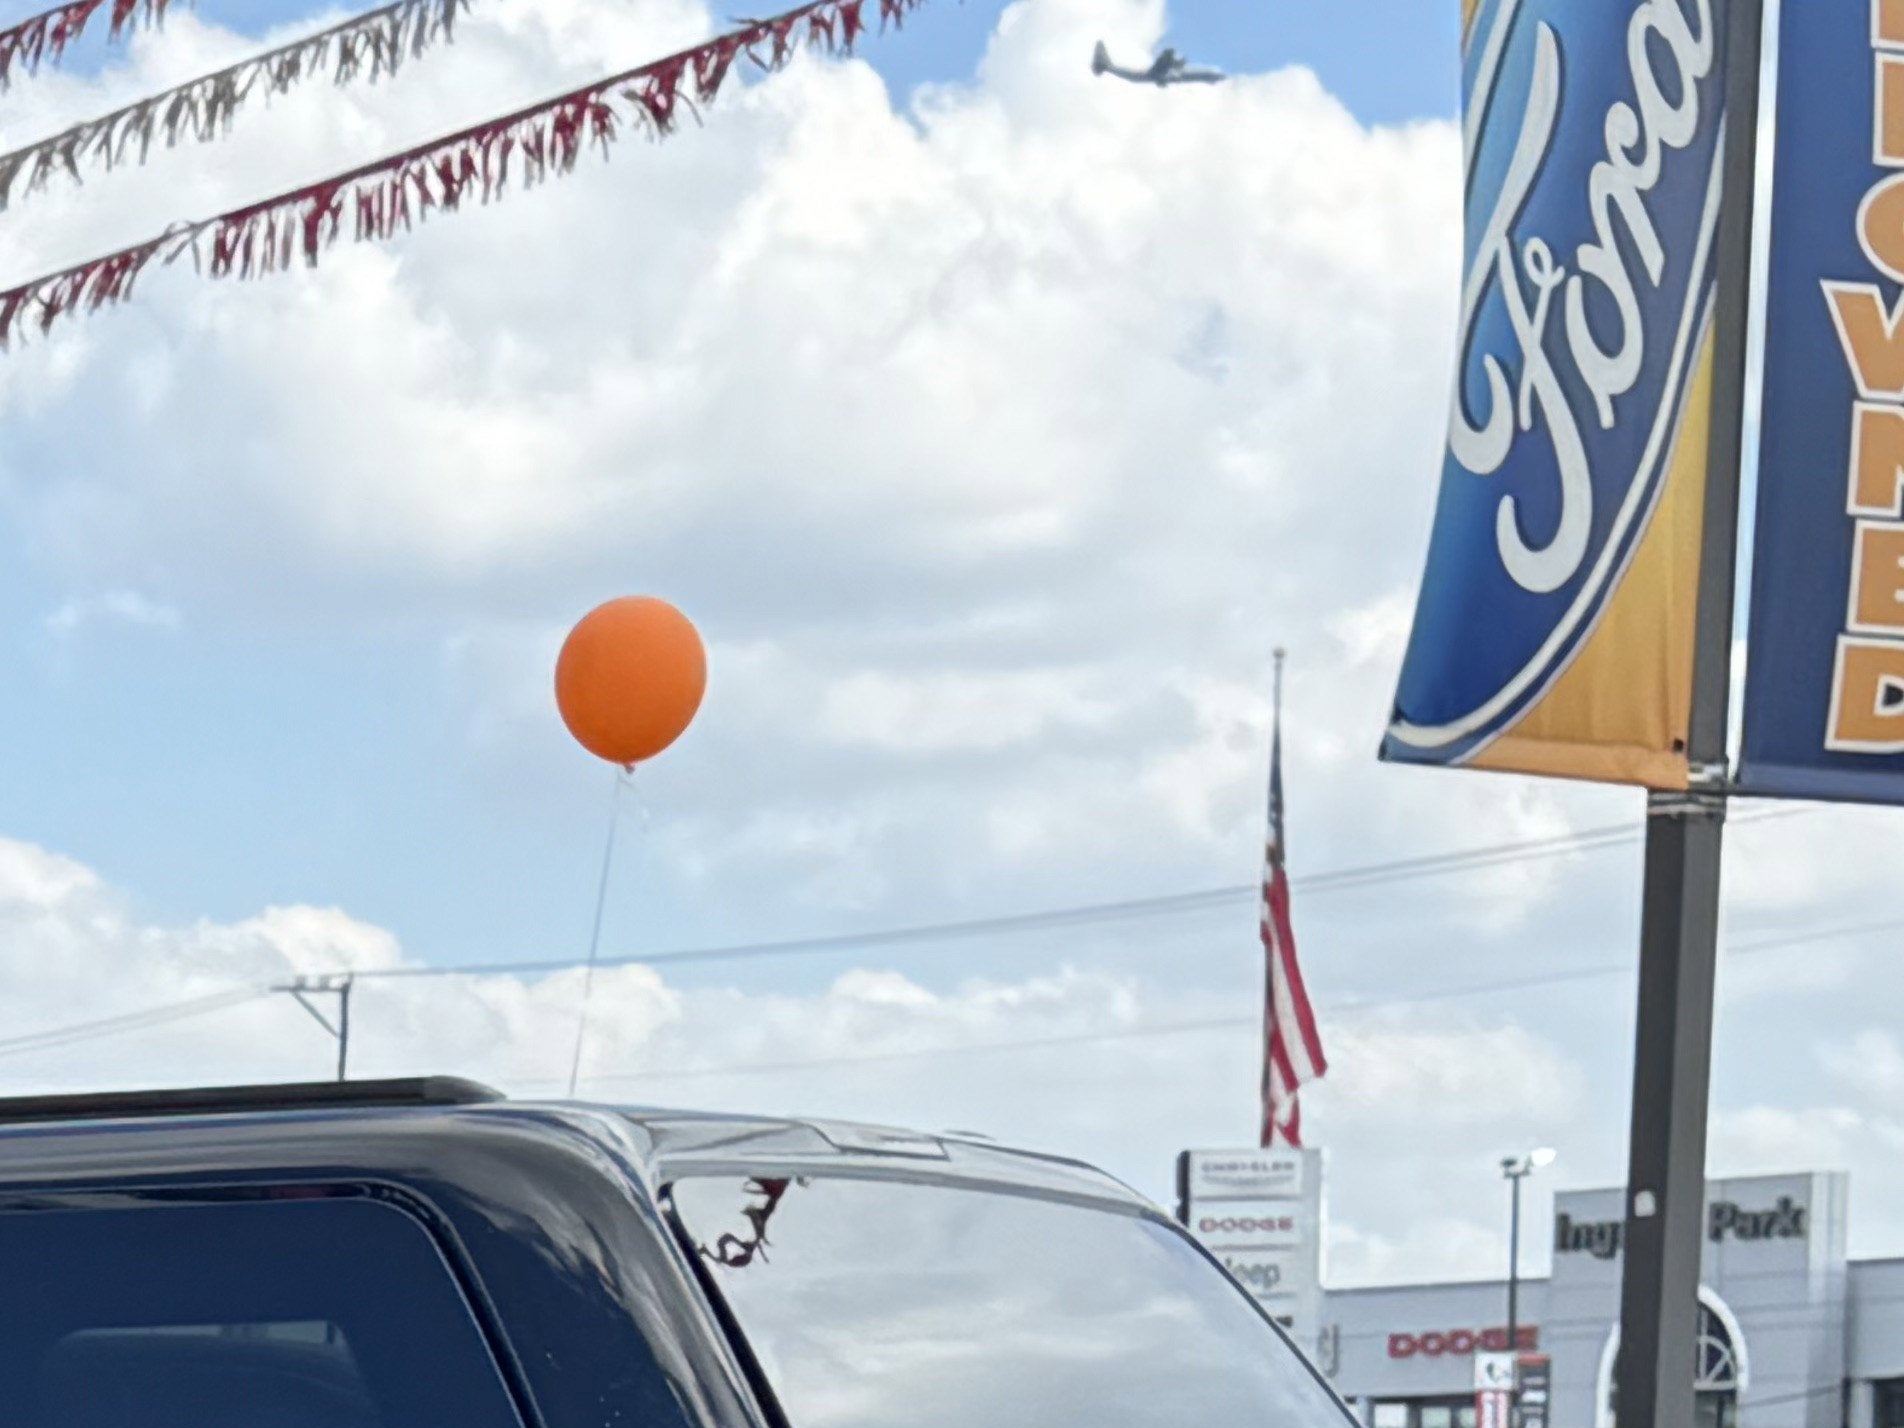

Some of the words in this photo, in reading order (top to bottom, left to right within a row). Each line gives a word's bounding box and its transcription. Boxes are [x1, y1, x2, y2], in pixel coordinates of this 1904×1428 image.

[1198, 1216, 1294, 1234] DODGE
[1708, 1195, 1807, 1243] Park
[1387, 1325, 1539, 1359] DODGE
